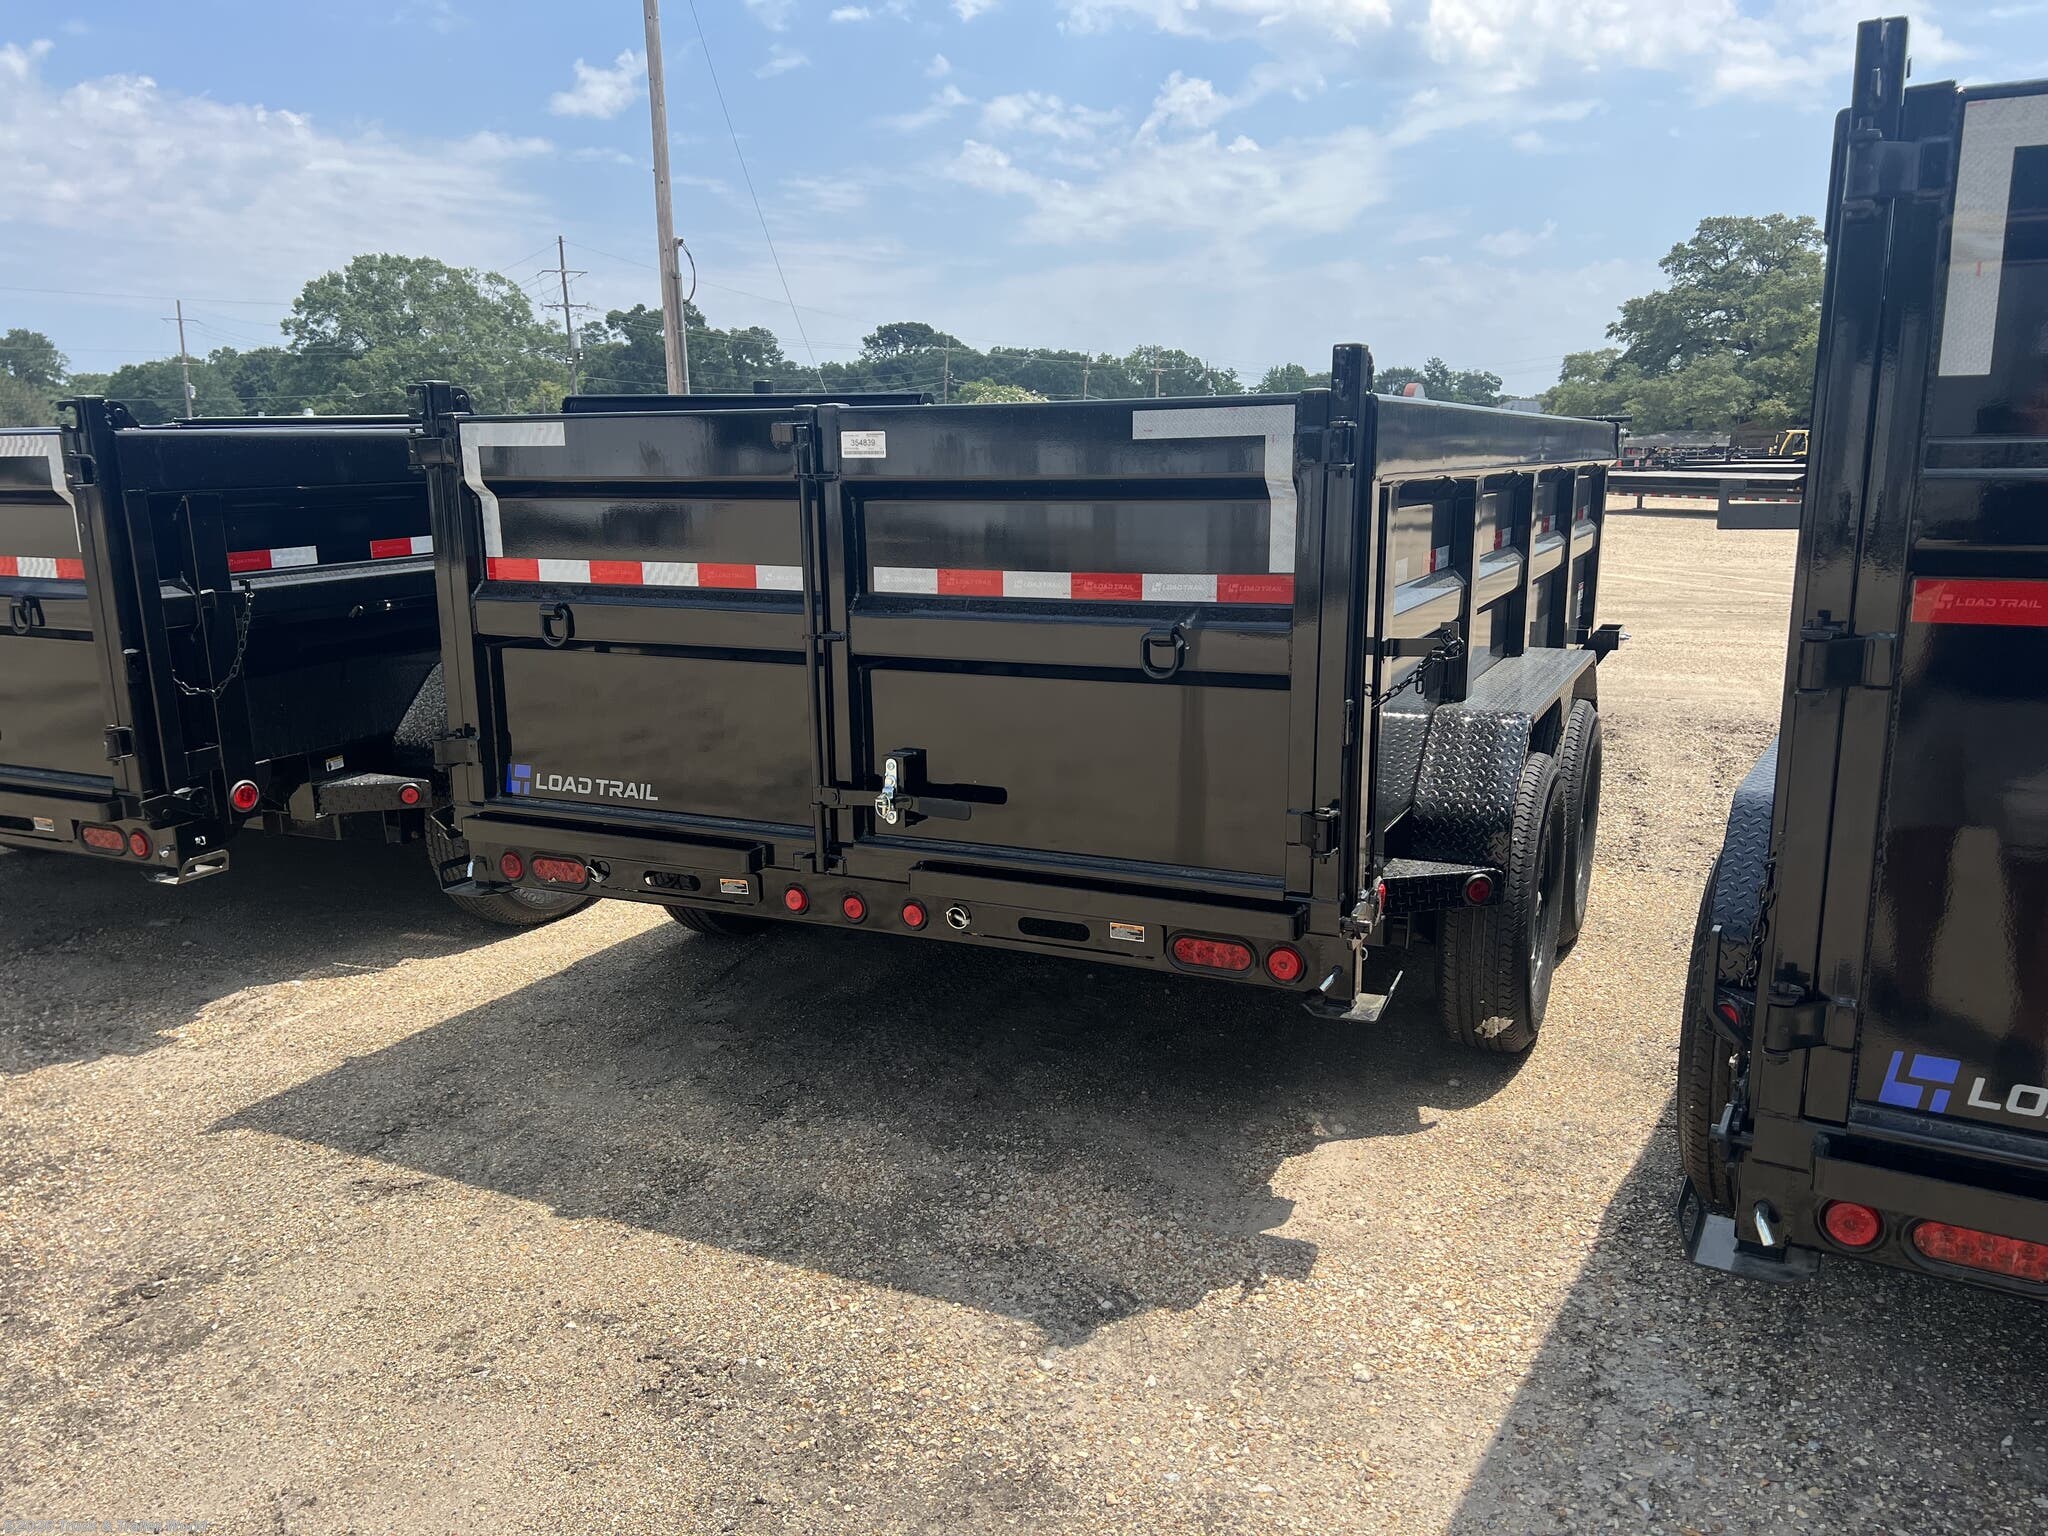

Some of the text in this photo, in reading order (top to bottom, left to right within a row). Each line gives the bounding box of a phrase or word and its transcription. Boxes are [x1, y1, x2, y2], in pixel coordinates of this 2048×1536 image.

[850, 438, 876, 447] 354839
[1955, 597, 1997, 608] LOAD
[1998, 599, 2043, 609] TRAIL
[535, 772, 592, 794] LOAD
[595, 778, 658, 801] TRAIL
[1967, 1076, 2048, 1119] LO
